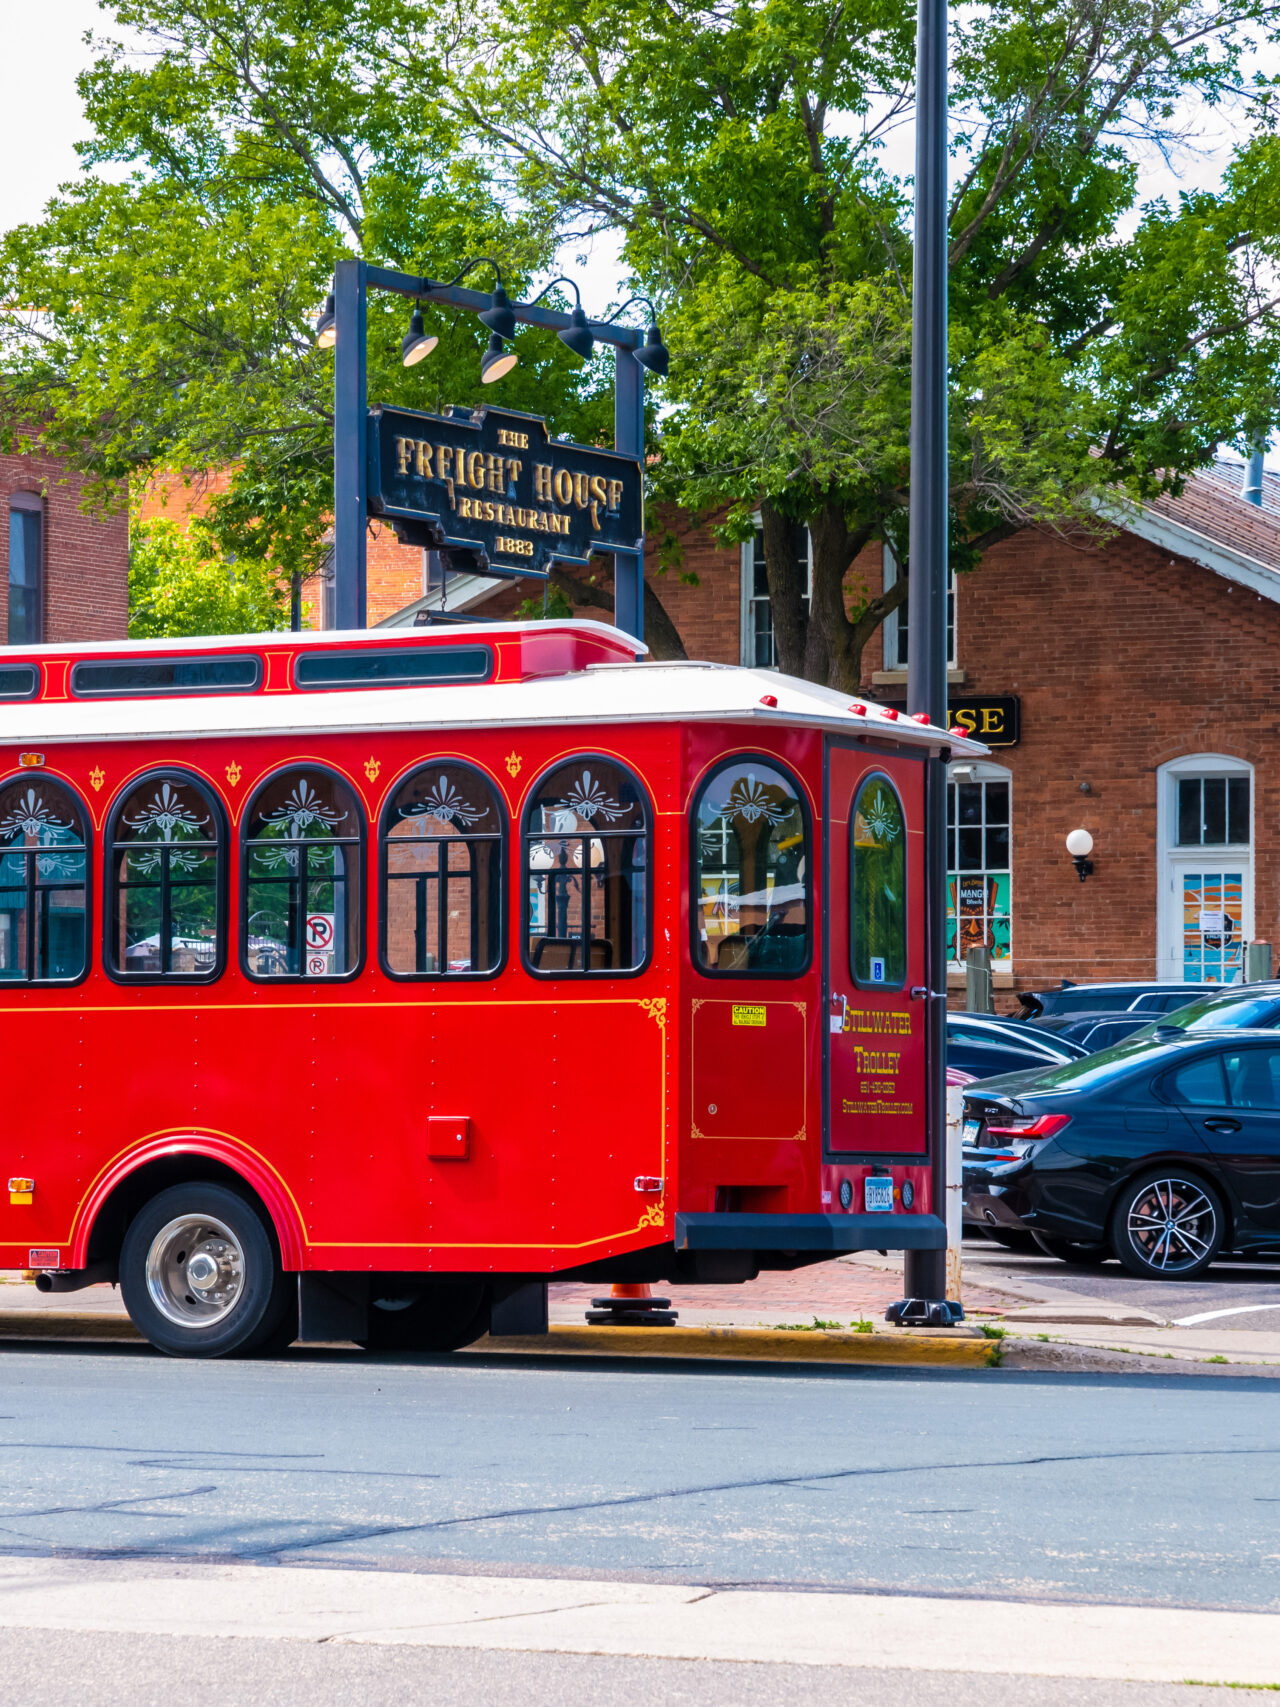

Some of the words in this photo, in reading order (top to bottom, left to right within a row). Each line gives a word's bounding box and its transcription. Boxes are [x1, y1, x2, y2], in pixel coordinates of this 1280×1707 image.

[498, 428, 528, 449] THE
[396, 437, 522, 495] FREIGHT
[534, 463, 624, 511] HOUSE
[459, 497, 570, 535] RESTAURANT
[495, 536, 534, 556] 1883
[734, 1006, 764, 1014] CAUTION
[842, 1004, 912, 1035] STILLWATER
[854, 1045, 900, 1074] TROLLEY
